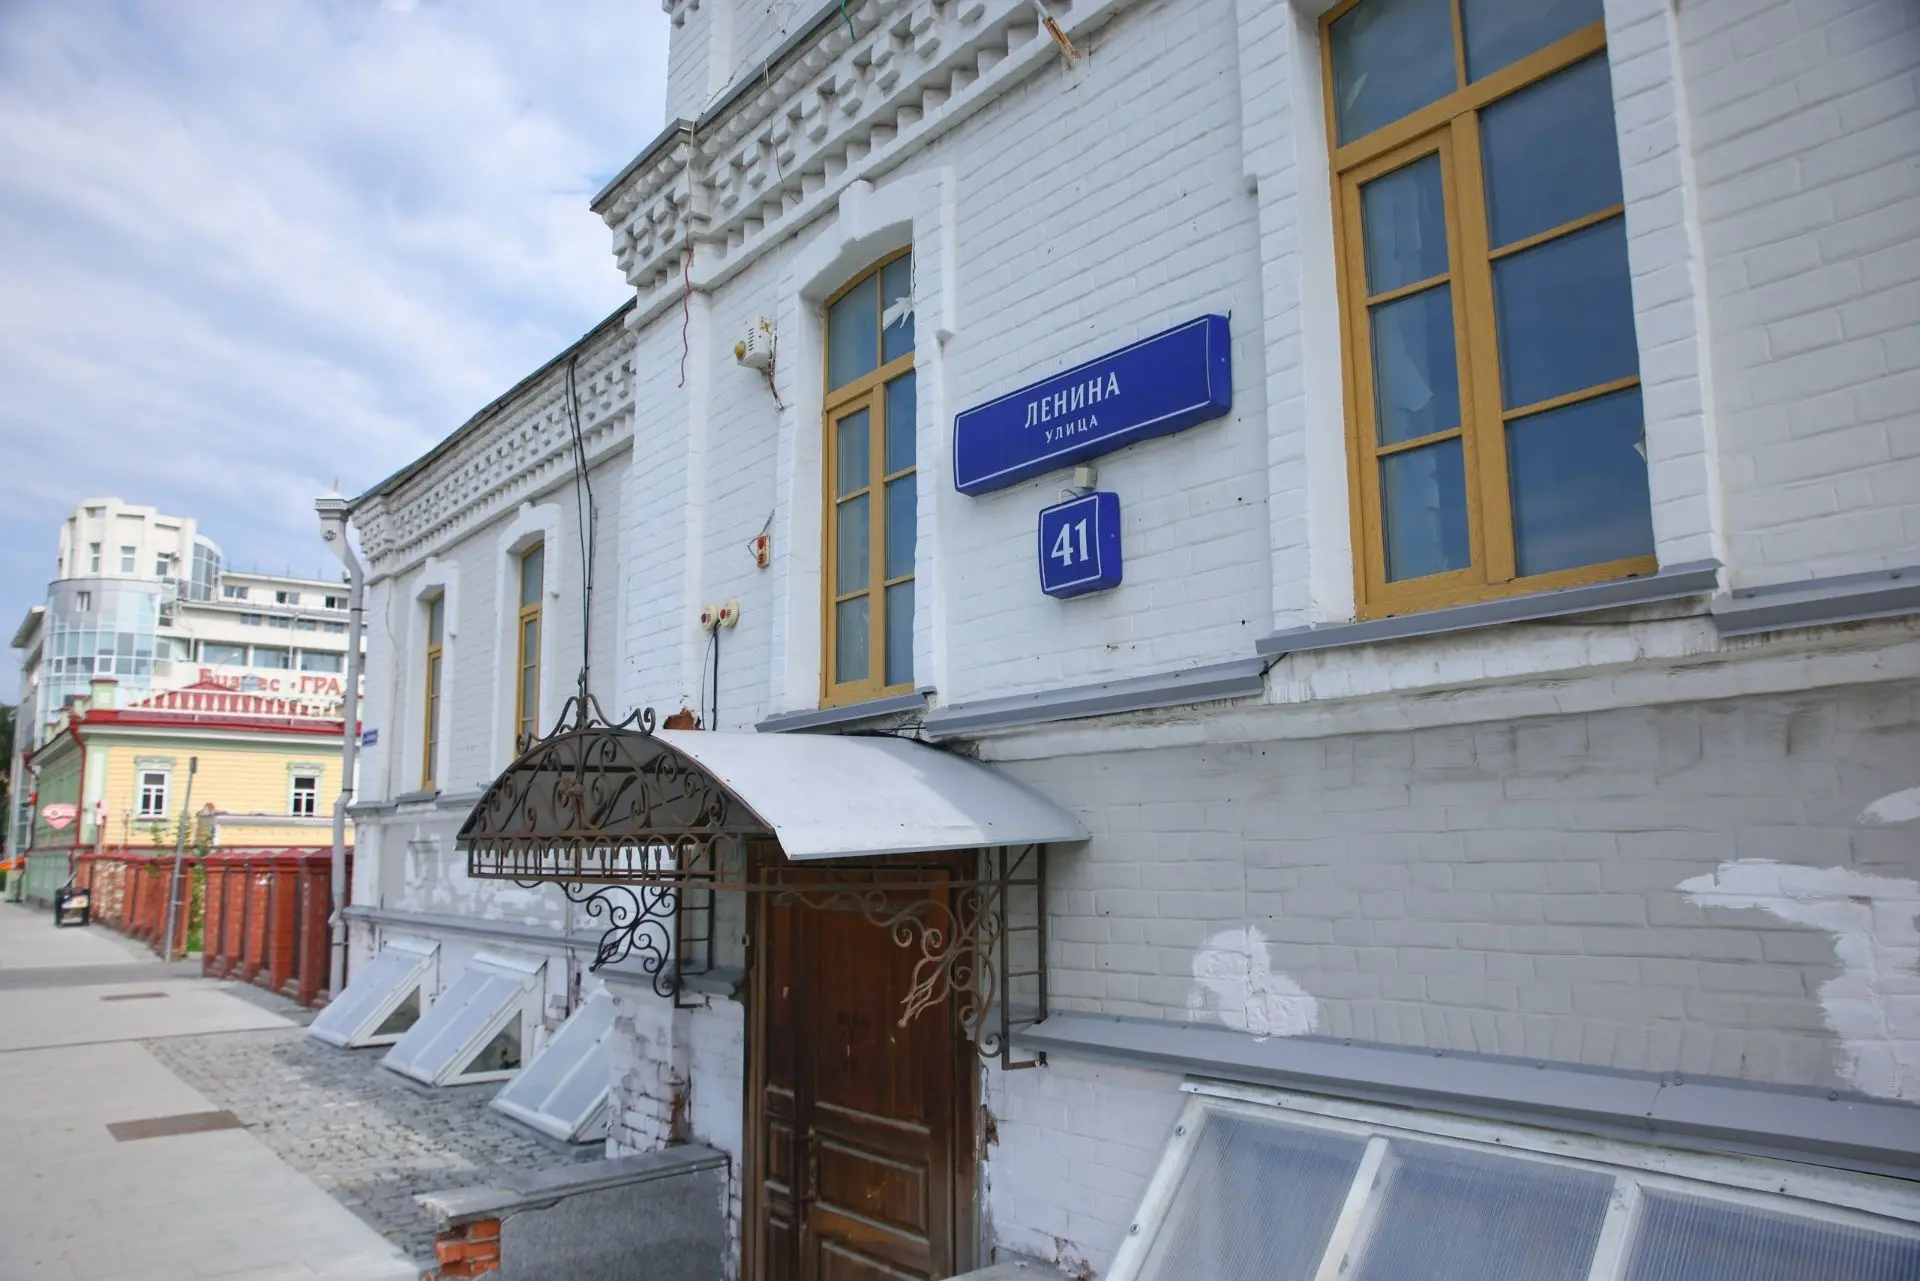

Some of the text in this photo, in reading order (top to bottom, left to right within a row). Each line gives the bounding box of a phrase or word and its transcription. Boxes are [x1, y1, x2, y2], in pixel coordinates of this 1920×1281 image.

[1025, 371, 1120, 427] ЛЕНИНА
[1045, 414, 1098, 443] УЛИЦА
[1051, 518, 1089, 566] 41
[199, 668, 280, 692] Бизес
